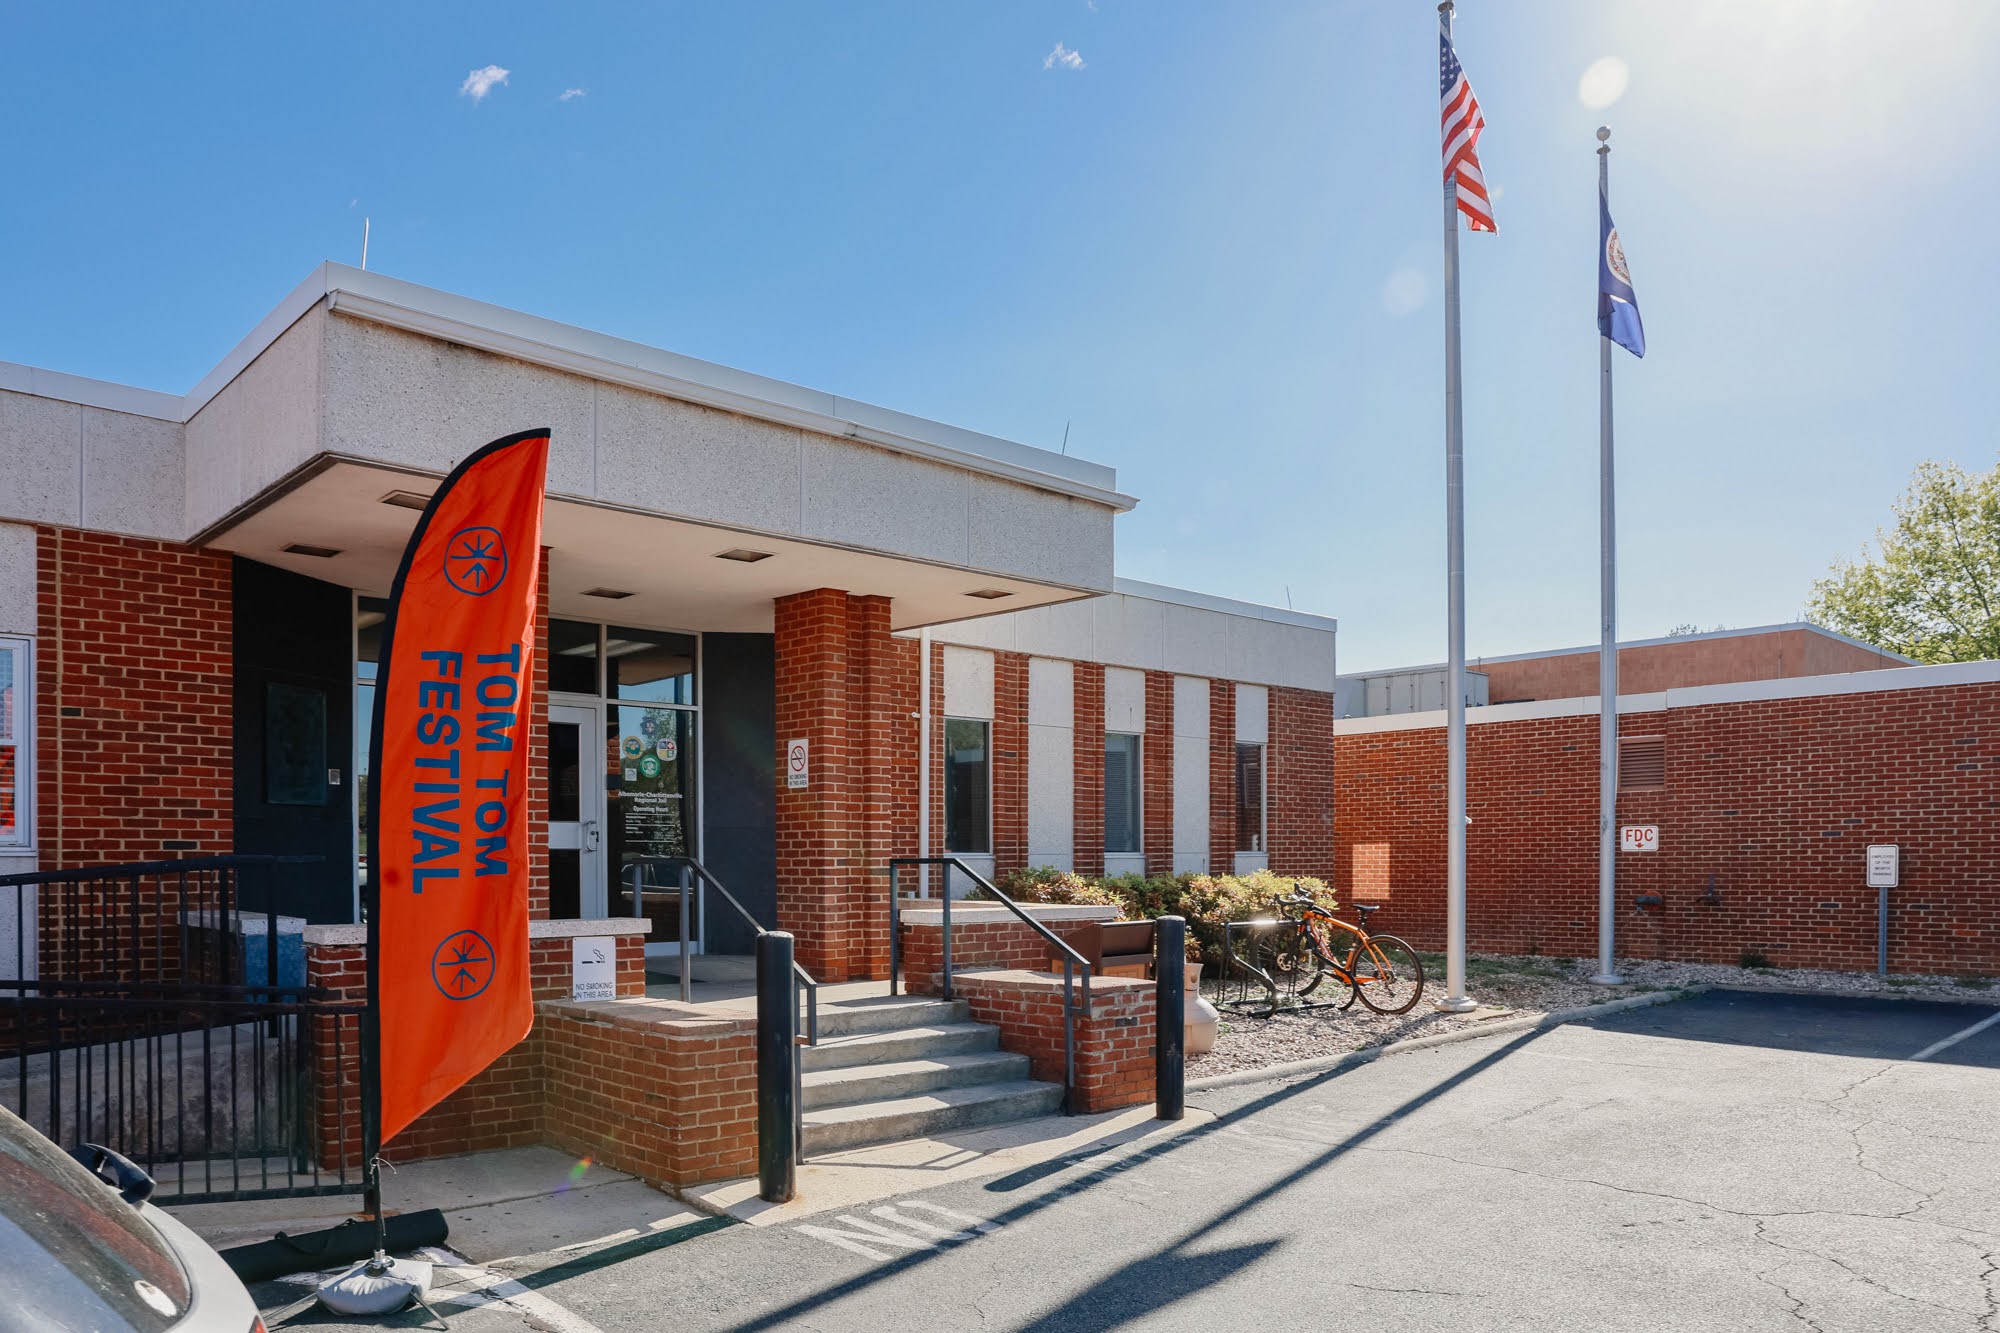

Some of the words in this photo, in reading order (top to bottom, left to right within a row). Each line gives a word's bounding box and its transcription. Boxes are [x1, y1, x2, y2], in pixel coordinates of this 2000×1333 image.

[474, 643, 521, 752] TOM
[412, 650, 463, 893] FESTIVAL
[474, 769, 509, 877] TOM
[633, 805, 655, 813] Operating
[1625, 829, 1654, 842] FDC
[575, 983, 584, 991] NO
[586, 982, 613, 991] SMOKING
[583, 991, 596, 999] THIS
[598, 990, 613, 998] AREA
[792, 1201, 1005, 1262] NO
